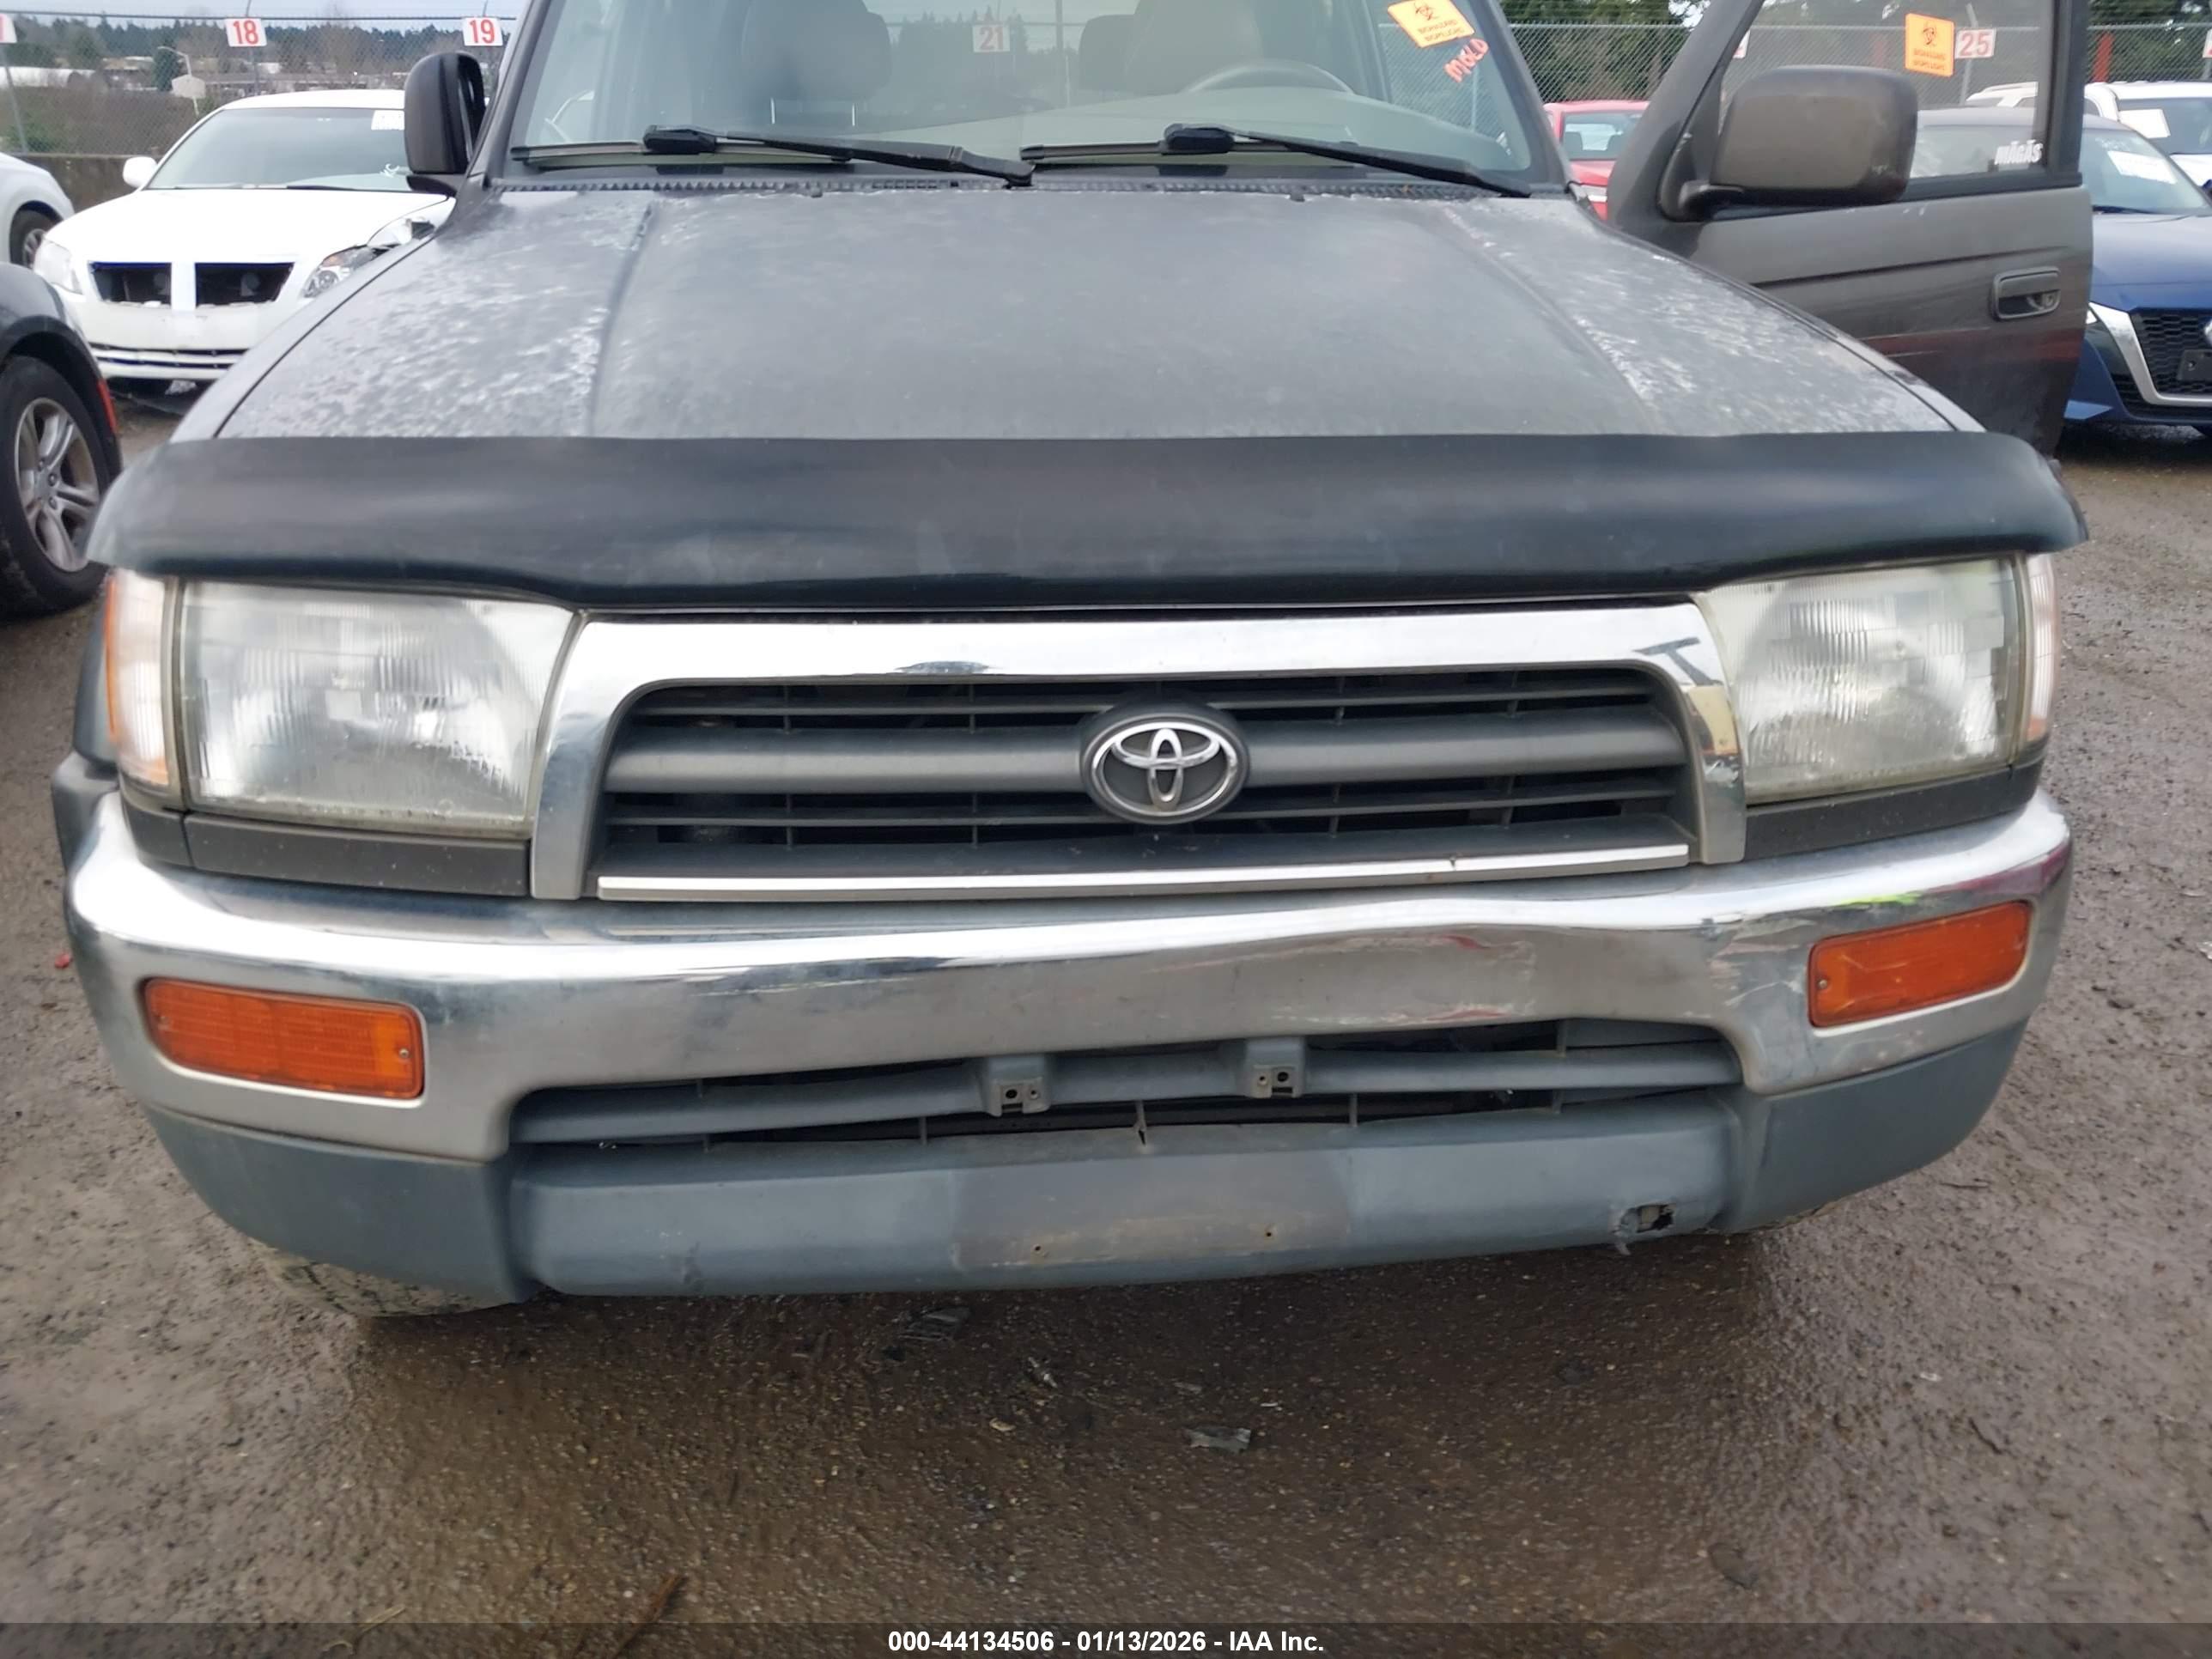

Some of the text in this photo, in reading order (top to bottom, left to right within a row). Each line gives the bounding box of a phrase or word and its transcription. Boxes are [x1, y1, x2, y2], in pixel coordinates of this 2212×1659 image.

[233, 20, 259, 45] 18
[469, 19, 495, 44] 19
[979, 27, 1004, 51] 21
[1959, 32, 1991, 56] 25
